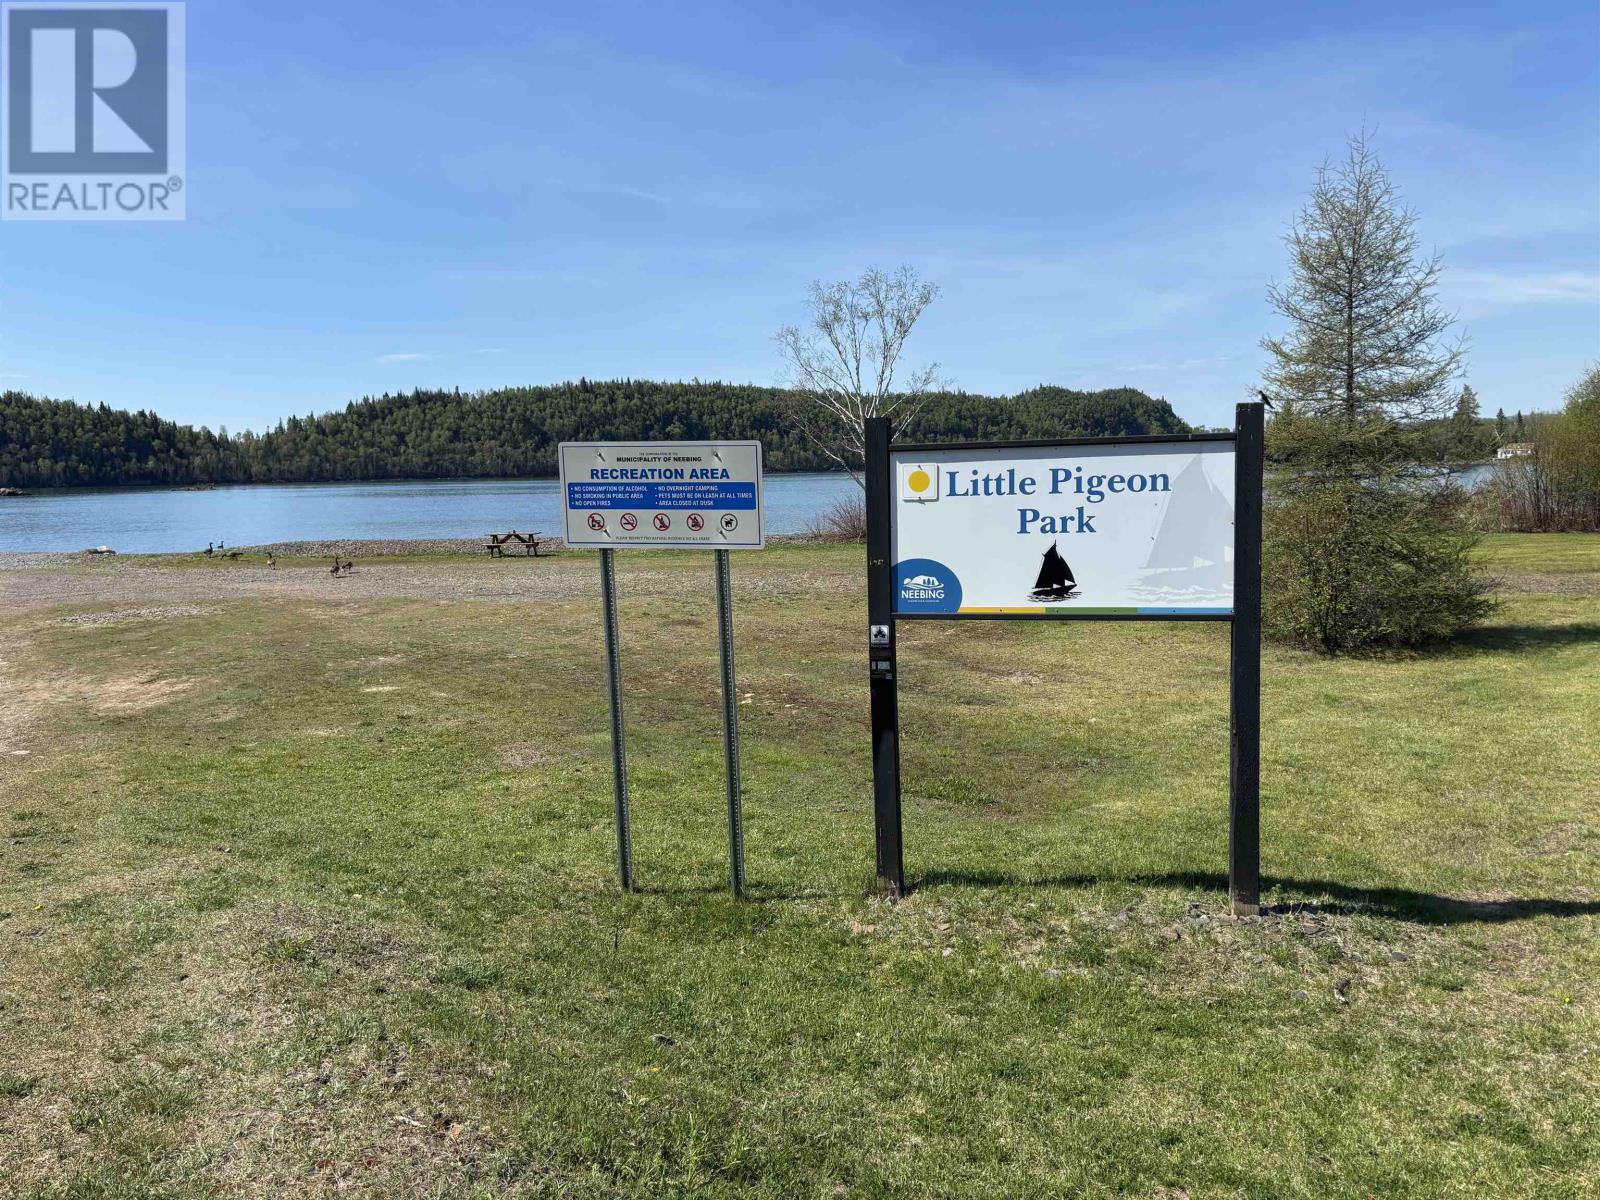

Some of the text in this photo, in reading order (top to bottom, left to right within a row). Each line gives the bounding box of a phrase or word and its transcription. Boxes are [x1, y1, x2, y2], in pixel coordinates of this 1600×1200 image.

[590, 468, 730, 479] RECREATION AREA
[945, 466, 1172, 504] Little Pigeon
[1016, 506, 1096, 535] Park
[901, 590, 945, 599] NEEBING
